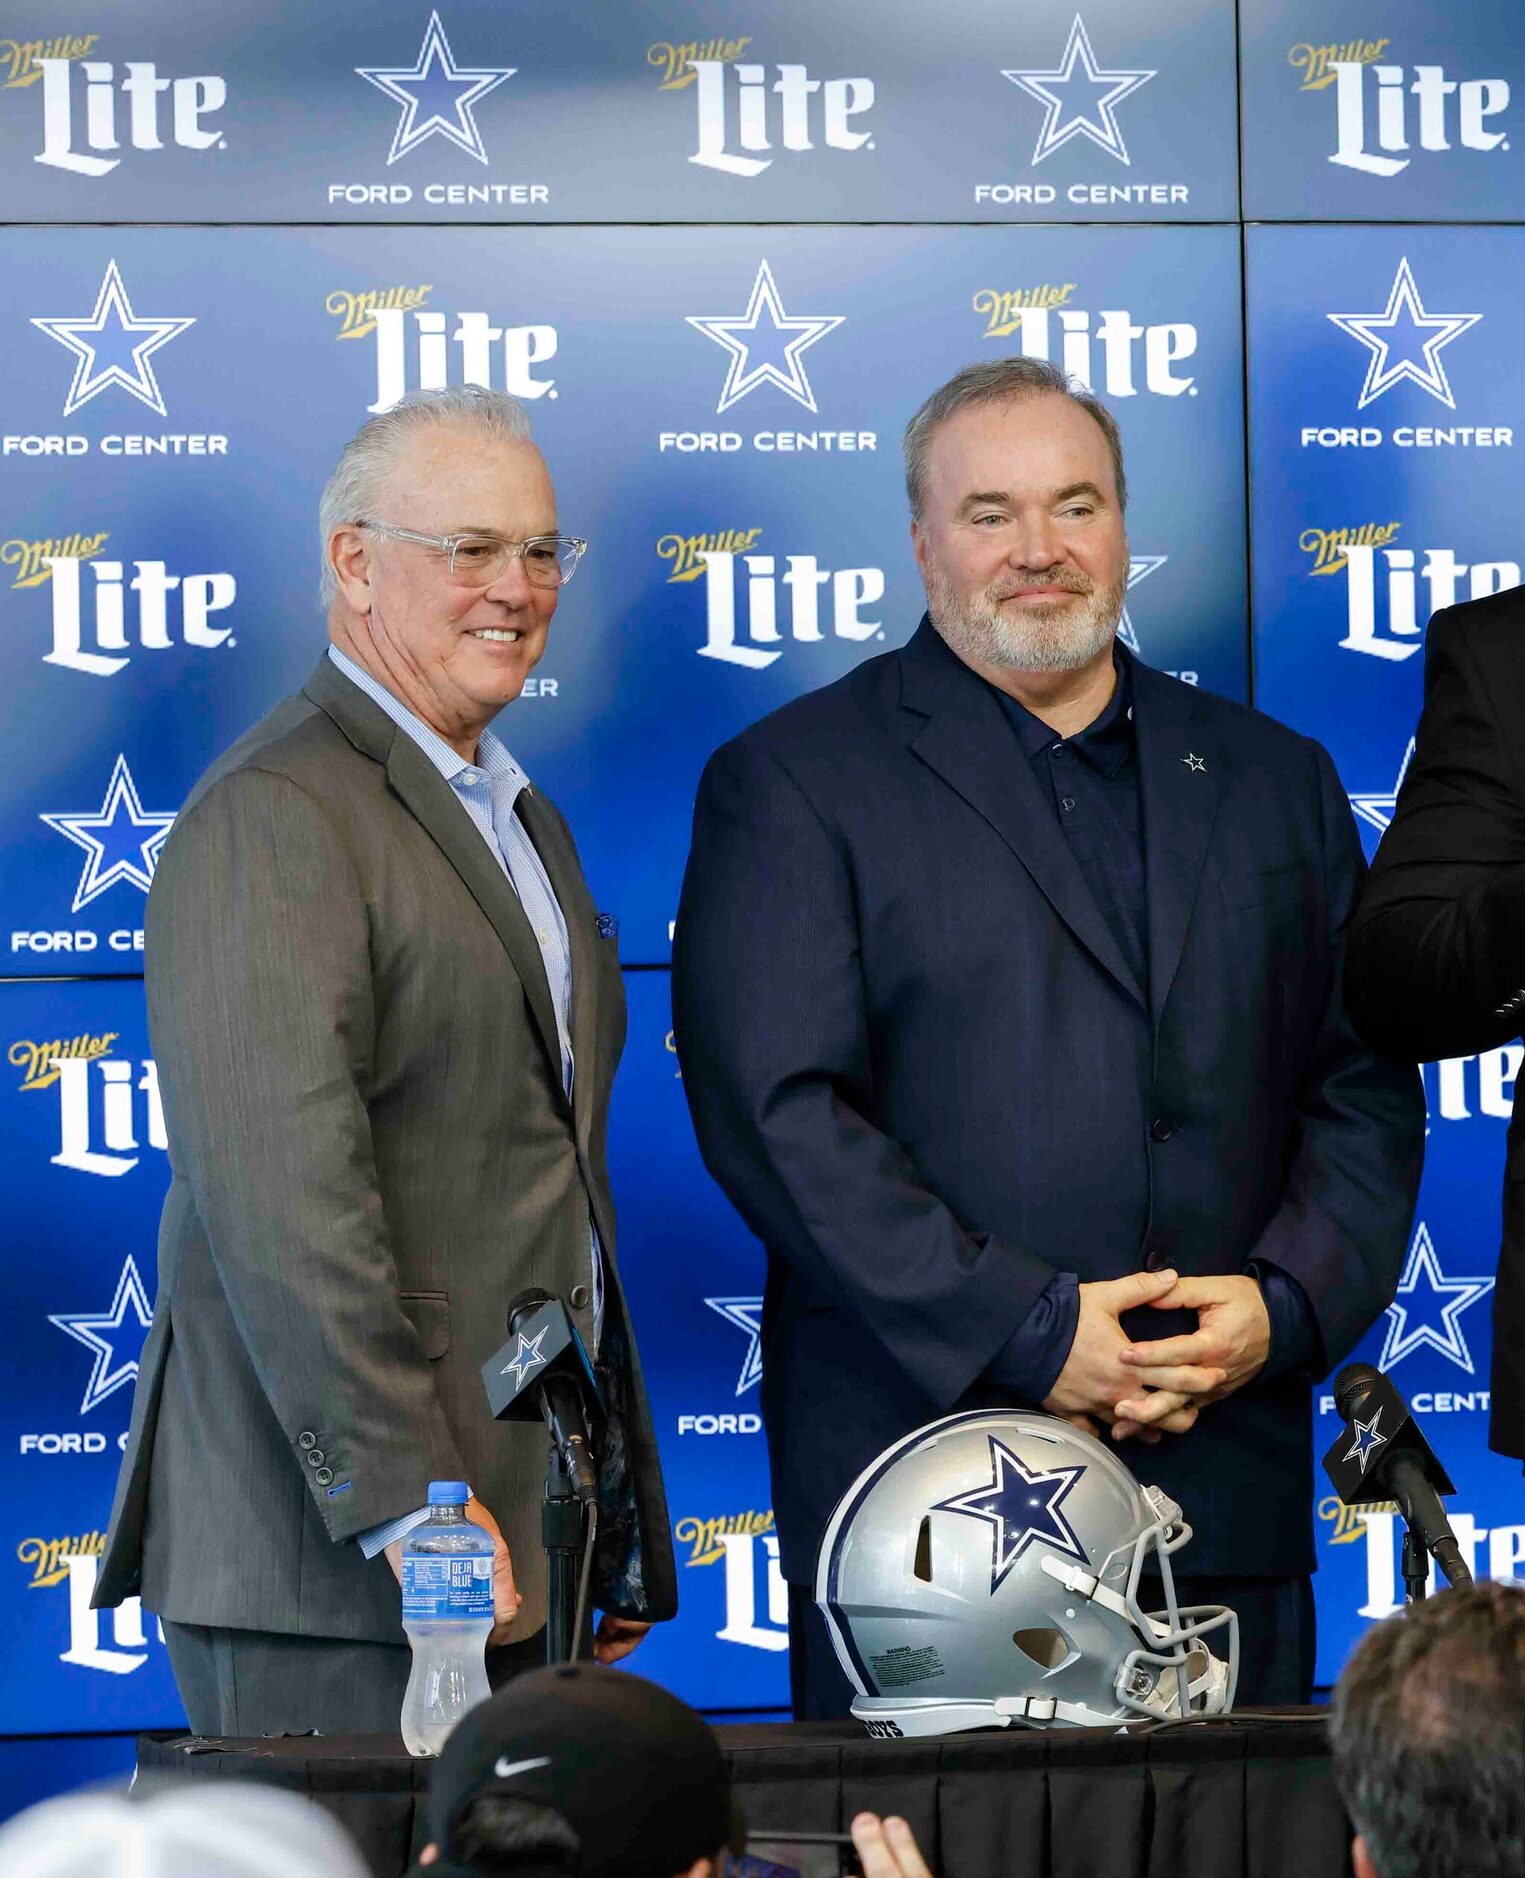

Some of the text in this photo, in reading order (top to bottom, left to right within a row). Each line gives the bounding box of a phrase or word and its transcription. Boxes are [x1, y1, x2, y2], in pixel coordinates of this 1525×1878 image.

[0, 35, 100, 89] Miller
[647, 37, 753, 90] Miller
[1288, 39, 1390, 91] Miller
[33, 57, 227, 176] Lite
[687, 60, 875, 176] Lite
[1326, 61, 1510, 176] Lite
[329, 185, 549, 204] FORD CENTER
[974, 185, 1188, 204] FORD CENTER
[326, 284, 433, 341] Miller
[973, 283, 1078, 338] Miller
[3, 435, 228, 455] FORD CENTER
[659, 431, 876, 452] FORD CENTER
[1301, 427, 1513, 447] FORD CENTER
[1, 532, 110, 590] Miller
[657, 528, 762, 583] Miller
[1299, 522, 1400, 576] Miller
[41, 557, 237, 677] Lite
[695, 551, 885, 670] Lite
[11, 931, 96, 952] FORD
[9, 1032, 119, 1091] Miller
[677, 1415, 761, 1435] FORD
[1411, 1391, 1491, 1413] CENT
[20, 1433, 106, 1454] FORD
[452, 1562, 472, 1574] DEJA
[452, 1574, 472, 1587] BLUE
